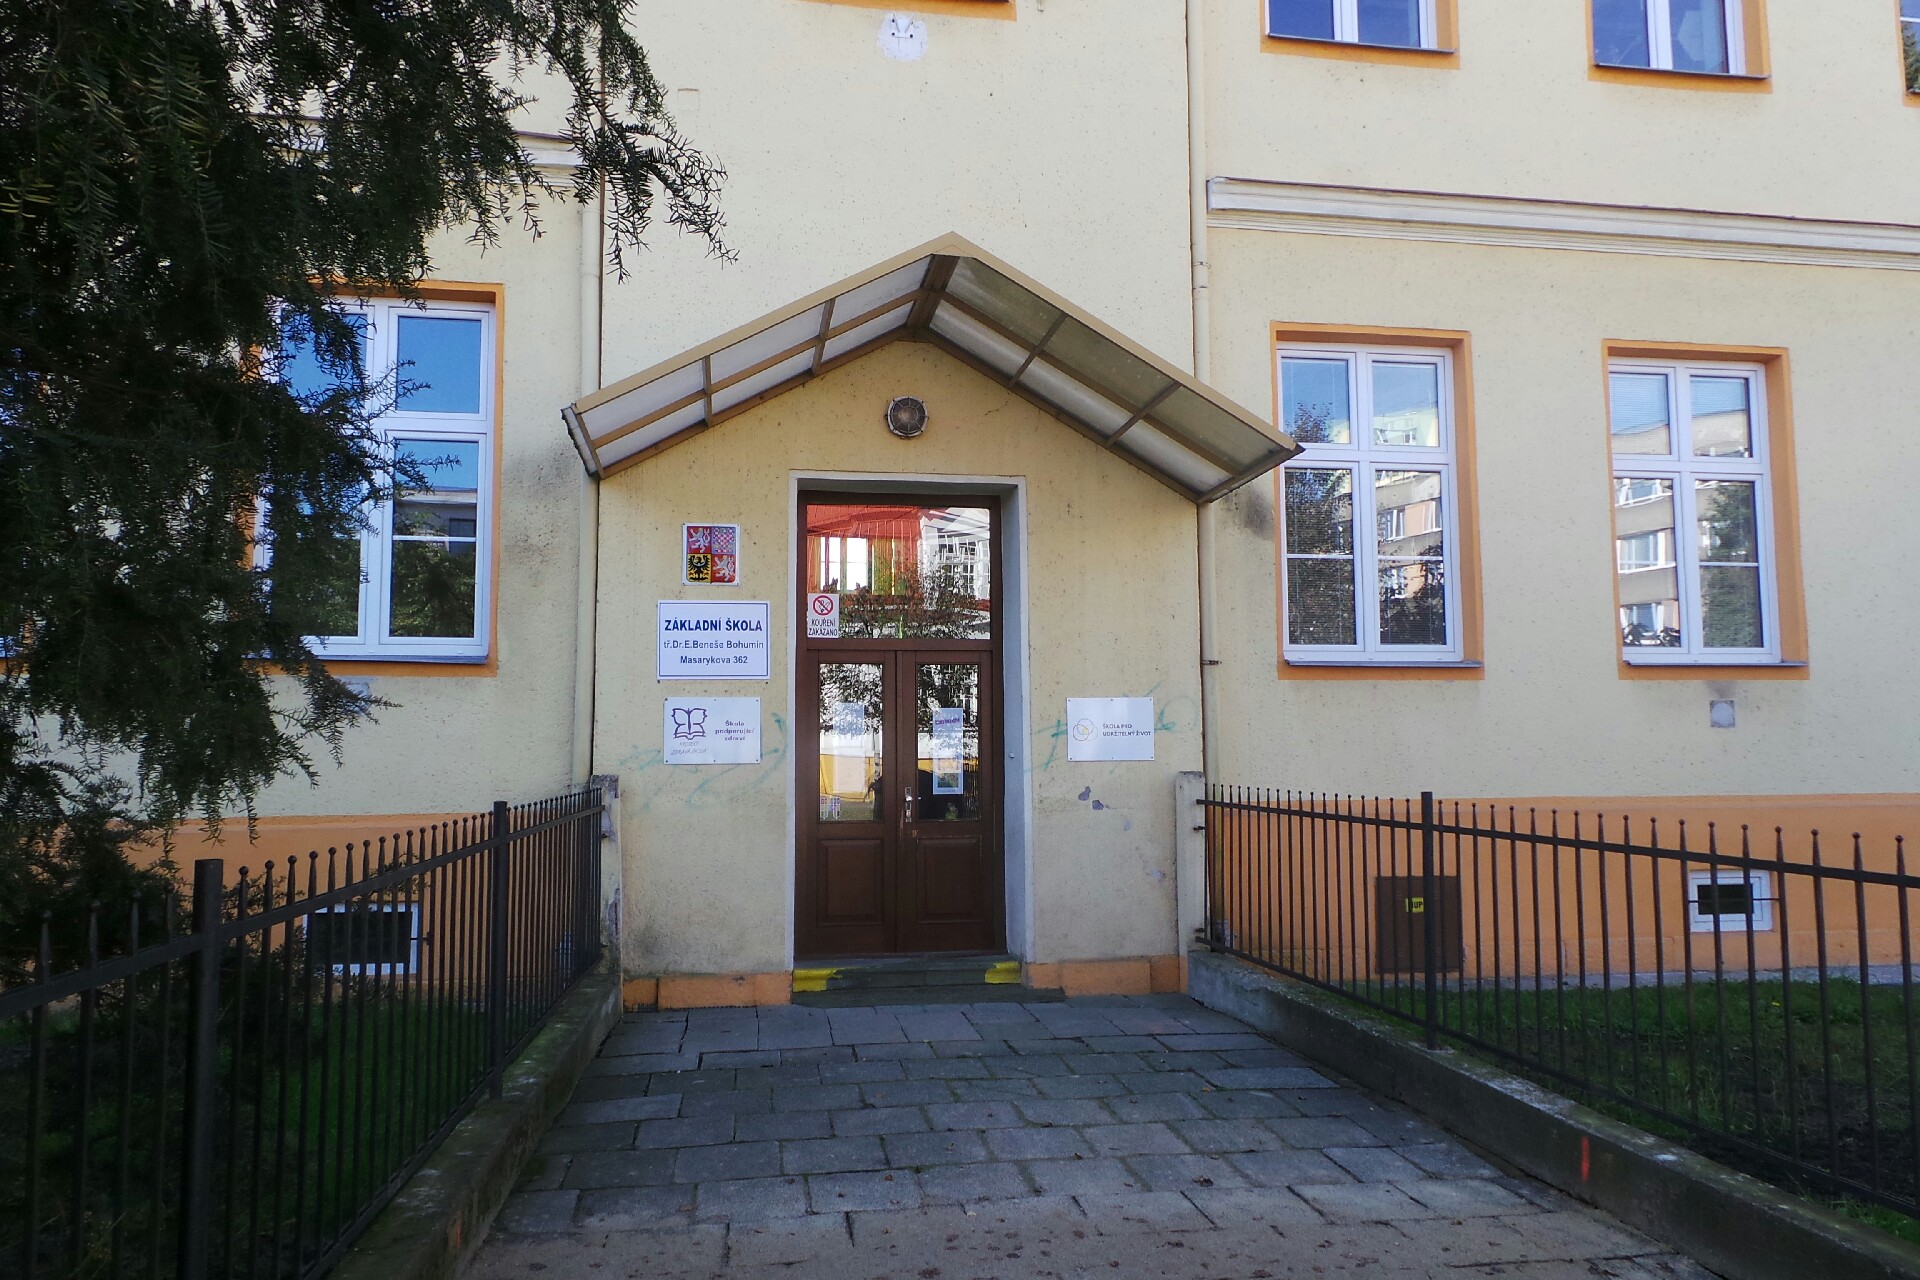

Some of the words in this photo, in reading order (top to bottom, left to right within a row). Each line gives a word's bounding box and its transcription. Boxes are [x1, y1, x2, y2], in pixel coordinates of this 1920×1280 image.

[664, 616, 722, 632] ZÁKLADNÍ
[725, 617, 763, 632] ŠKOLA
[680, 655, 731, 666] Masarykova
[732, 655, 748, 664] 362
[725, 719, 745, 727] Škola
